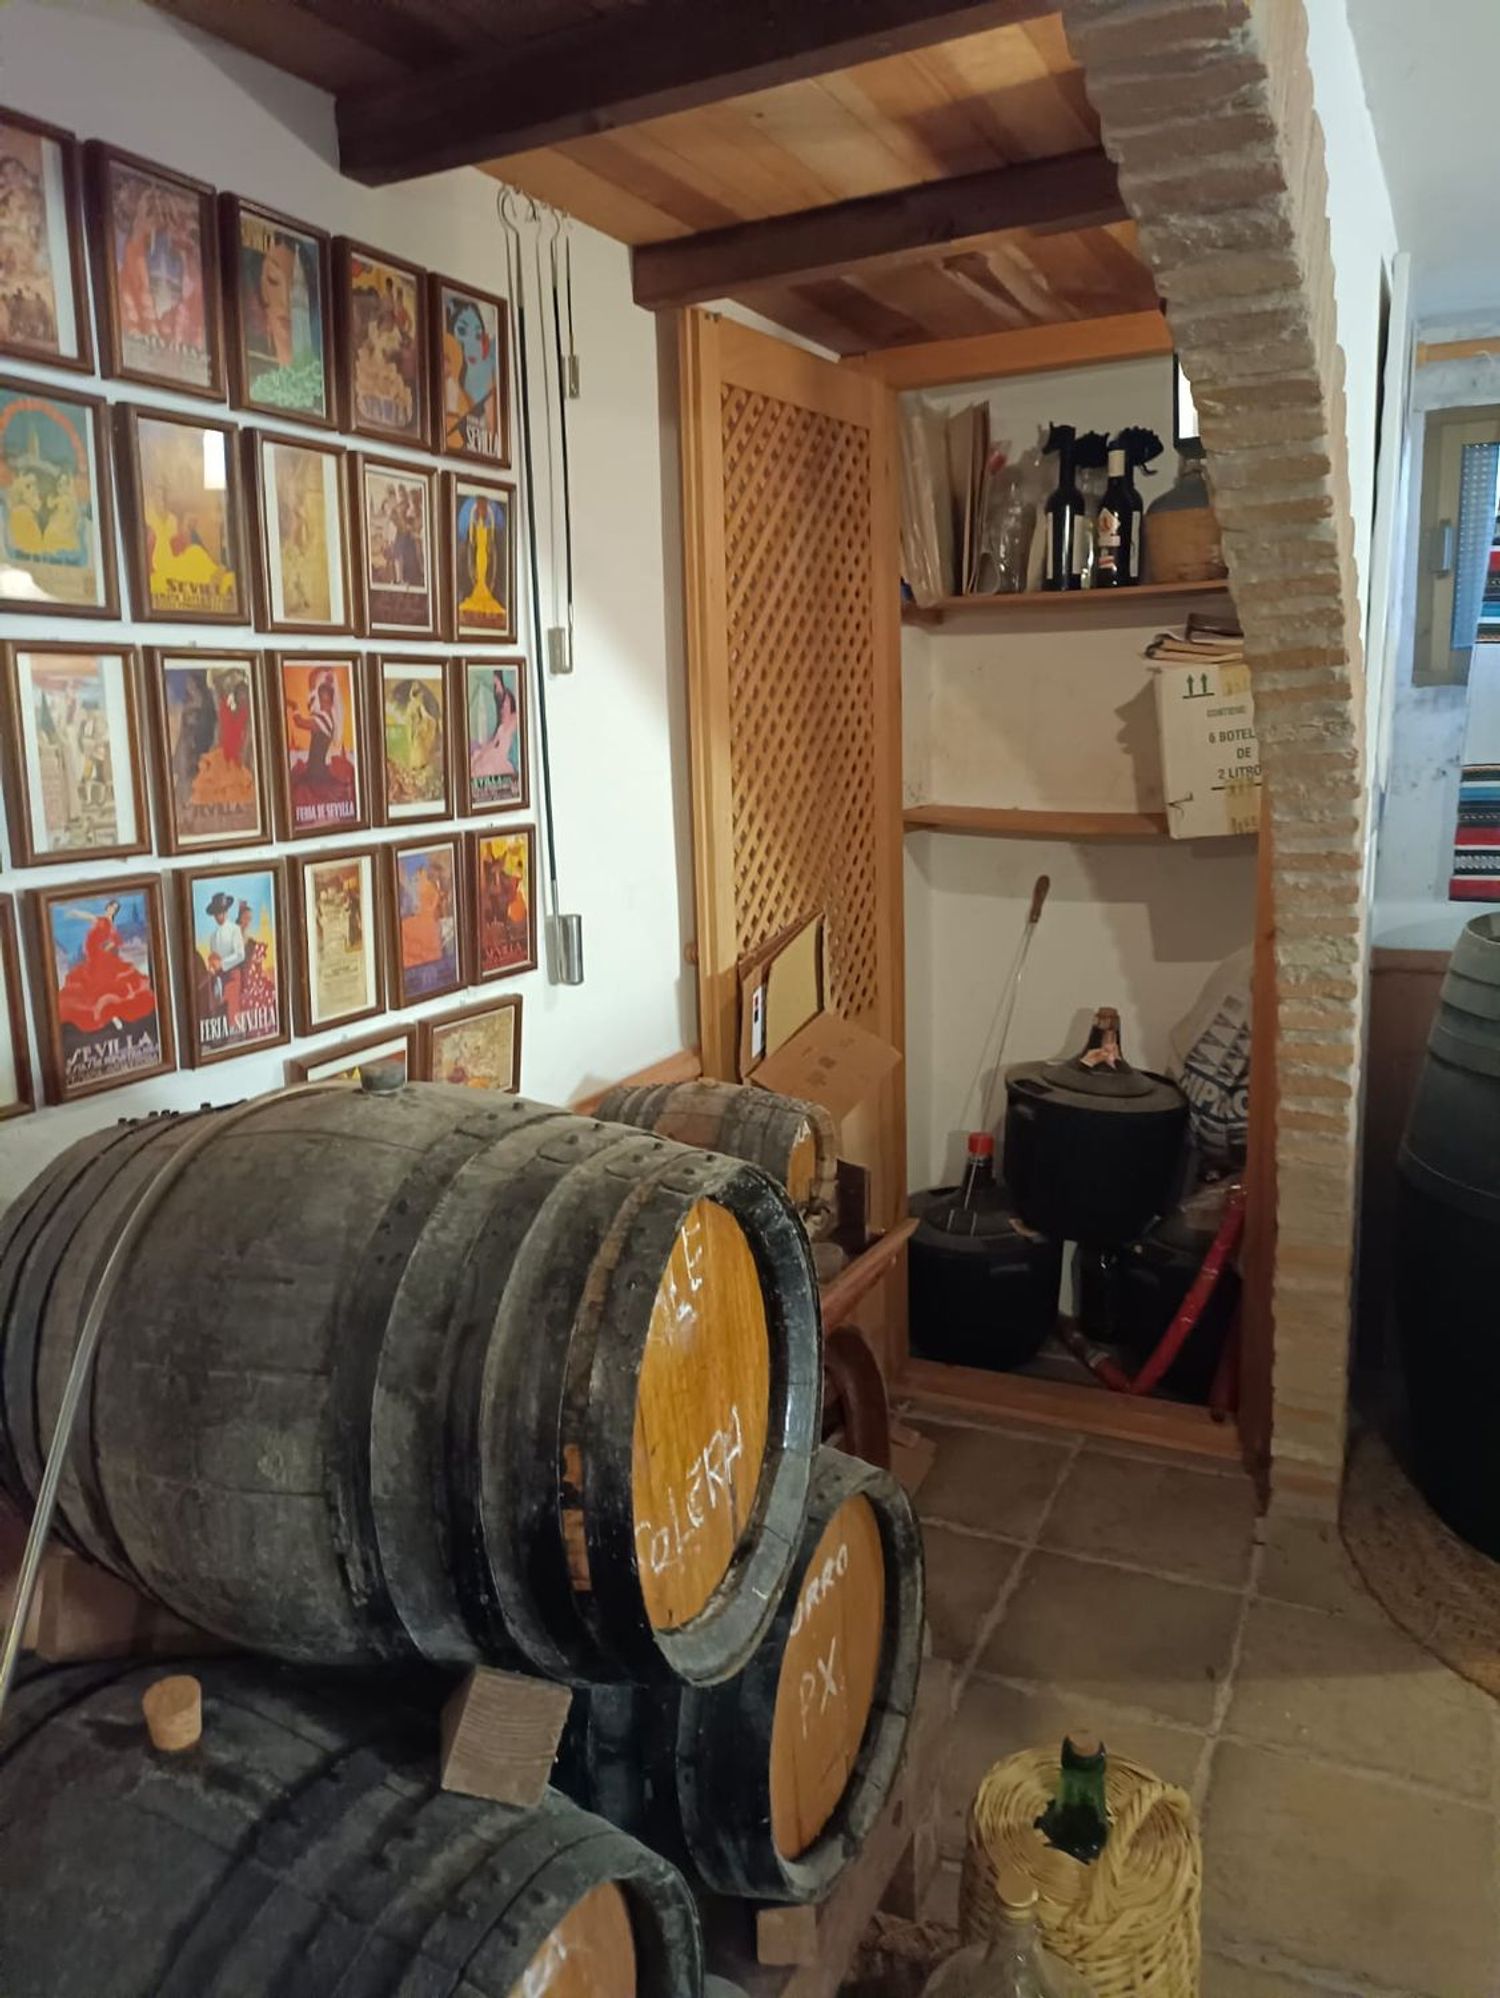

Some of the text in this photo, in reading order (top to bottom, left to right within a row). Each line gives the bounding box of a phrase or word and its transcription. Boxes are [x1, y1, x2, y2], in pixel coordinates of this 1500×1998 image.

[466, 427, 500, 457] SEVILLA
[1208, 731, 1216, 744] 6
[1236, 746, 1252, 759] DE
[1218, 767, 1225, 780] 2
[295, 804, 316, 821] FERIA
[326, 801, 355, 818] SEVILLA
[200, 1015, 228, 1043] FERIA
[67, 1031, 154, 1069] SEVILLA
[800, 1636, 838, 1740] PX
